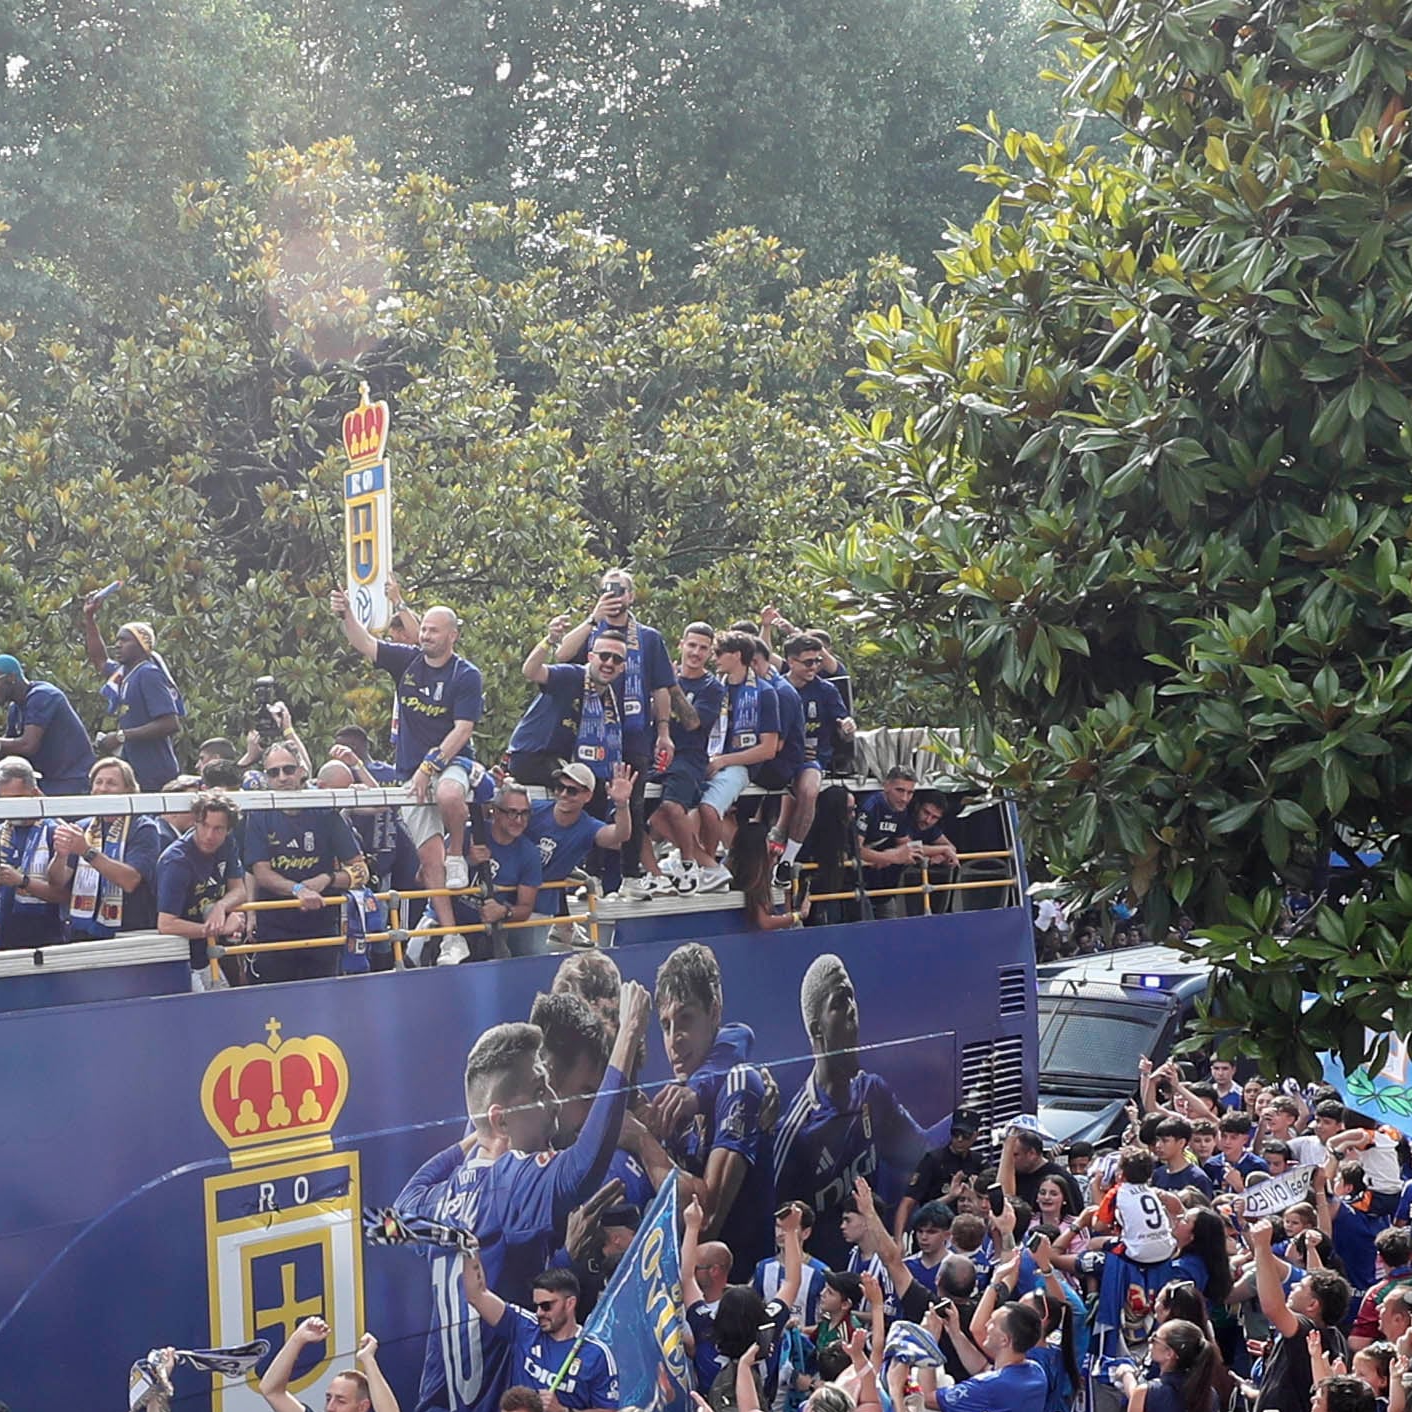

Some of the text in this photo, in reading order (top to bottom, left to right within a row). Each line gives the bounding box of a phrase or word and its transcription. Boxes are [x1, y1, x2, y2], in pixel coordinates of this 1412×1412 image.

[351, 470, 374, 495] RO
[1140, 1195, 1163, 1230] 9
[432, 1252, 484, 1412] 10
[524, 1357, 569, 1394] DIGI
